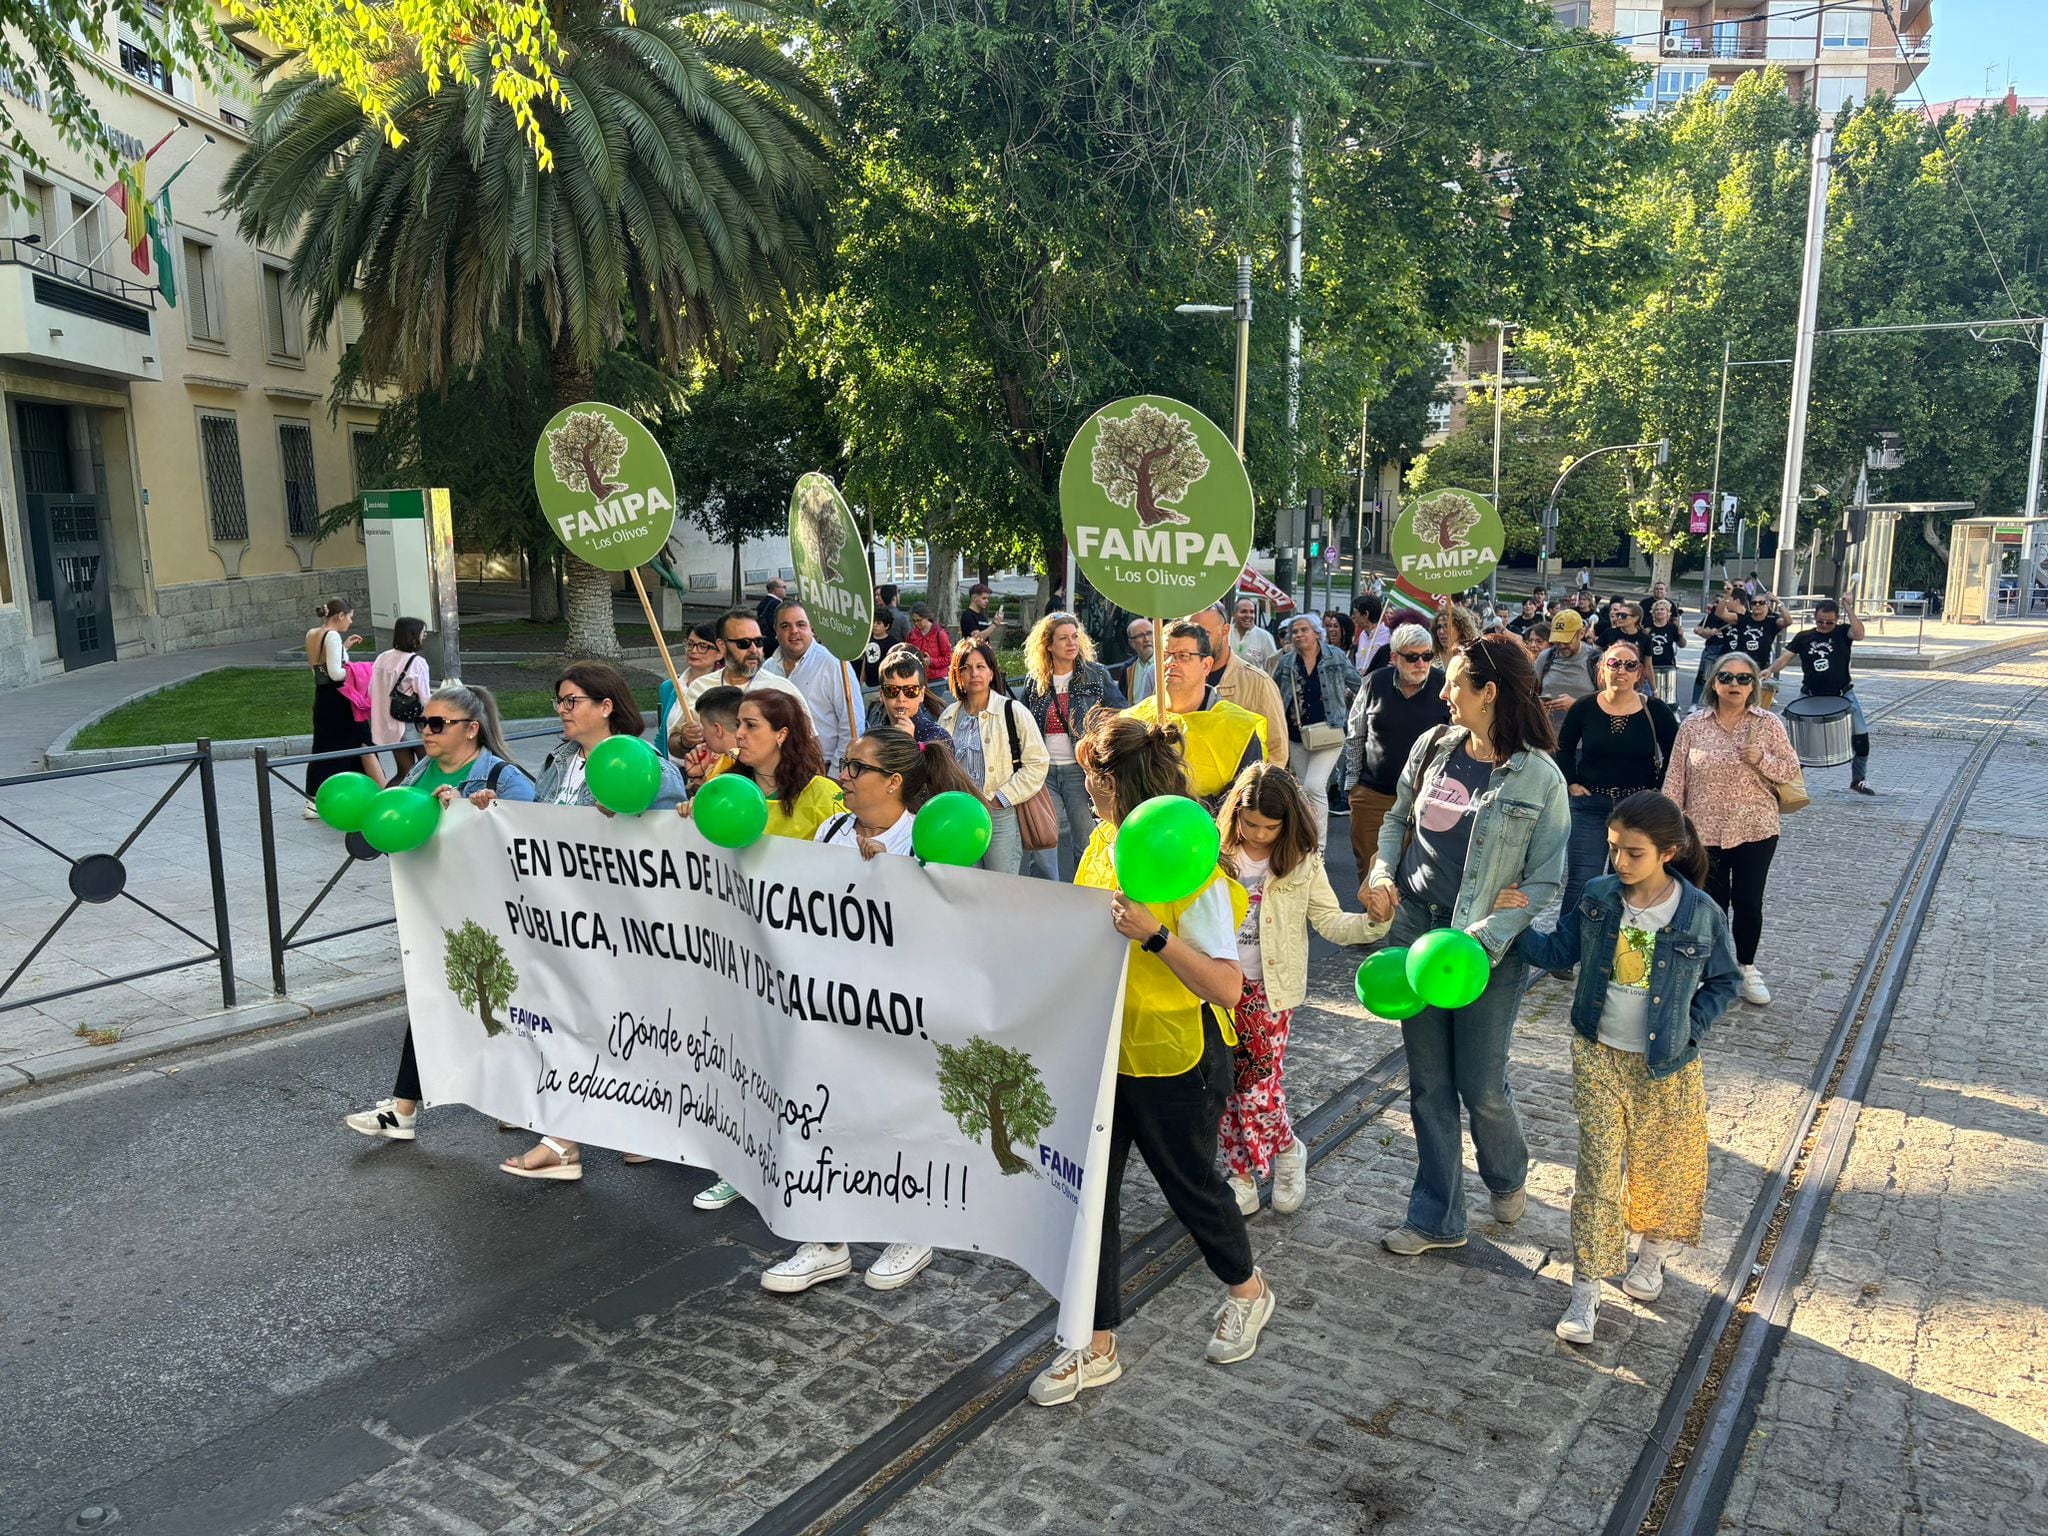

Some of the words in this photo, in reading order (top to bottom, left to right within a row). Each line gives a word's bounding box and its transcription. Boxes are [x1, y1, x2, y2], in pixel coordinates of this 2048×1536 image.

[557, 486, 672, 542] FAMPA
[1076, 525, 1241, 568] FAMPA
[798, 574, 870, 625] FAMPA
[1401, 546, 1497, 572] FAMPA
[506, 838, 552, 882] ¡EN
[557, 841, 681, 889] DEFENSA
[685, 850, 713, 896] DE
[715, 858, 736, 908] LA
[733, 869, 894, 948] EDUCACIÓN
[505, 894, 618, 957] PÚBLICA,
[621, 916, 739, 984] INCLUSIVA
[740, 945, 750, 990] Y
[754, 953, 775, 1006] DE
[776, 969, 928, 1041] CALIDAD!
[608, 1007, 681, 1061] ¿Dónde
[687, 1015, 726, 1073] están
[730, 1033, 749, 1100] los
[751, 1068, 830, 1141] recursos?
[536, 1051, 562, 1095] La
[568, 1053, 673, 1115] educación
[743, 1107, 756, 1158] lo
[758, 1127, 780, 1188] está
